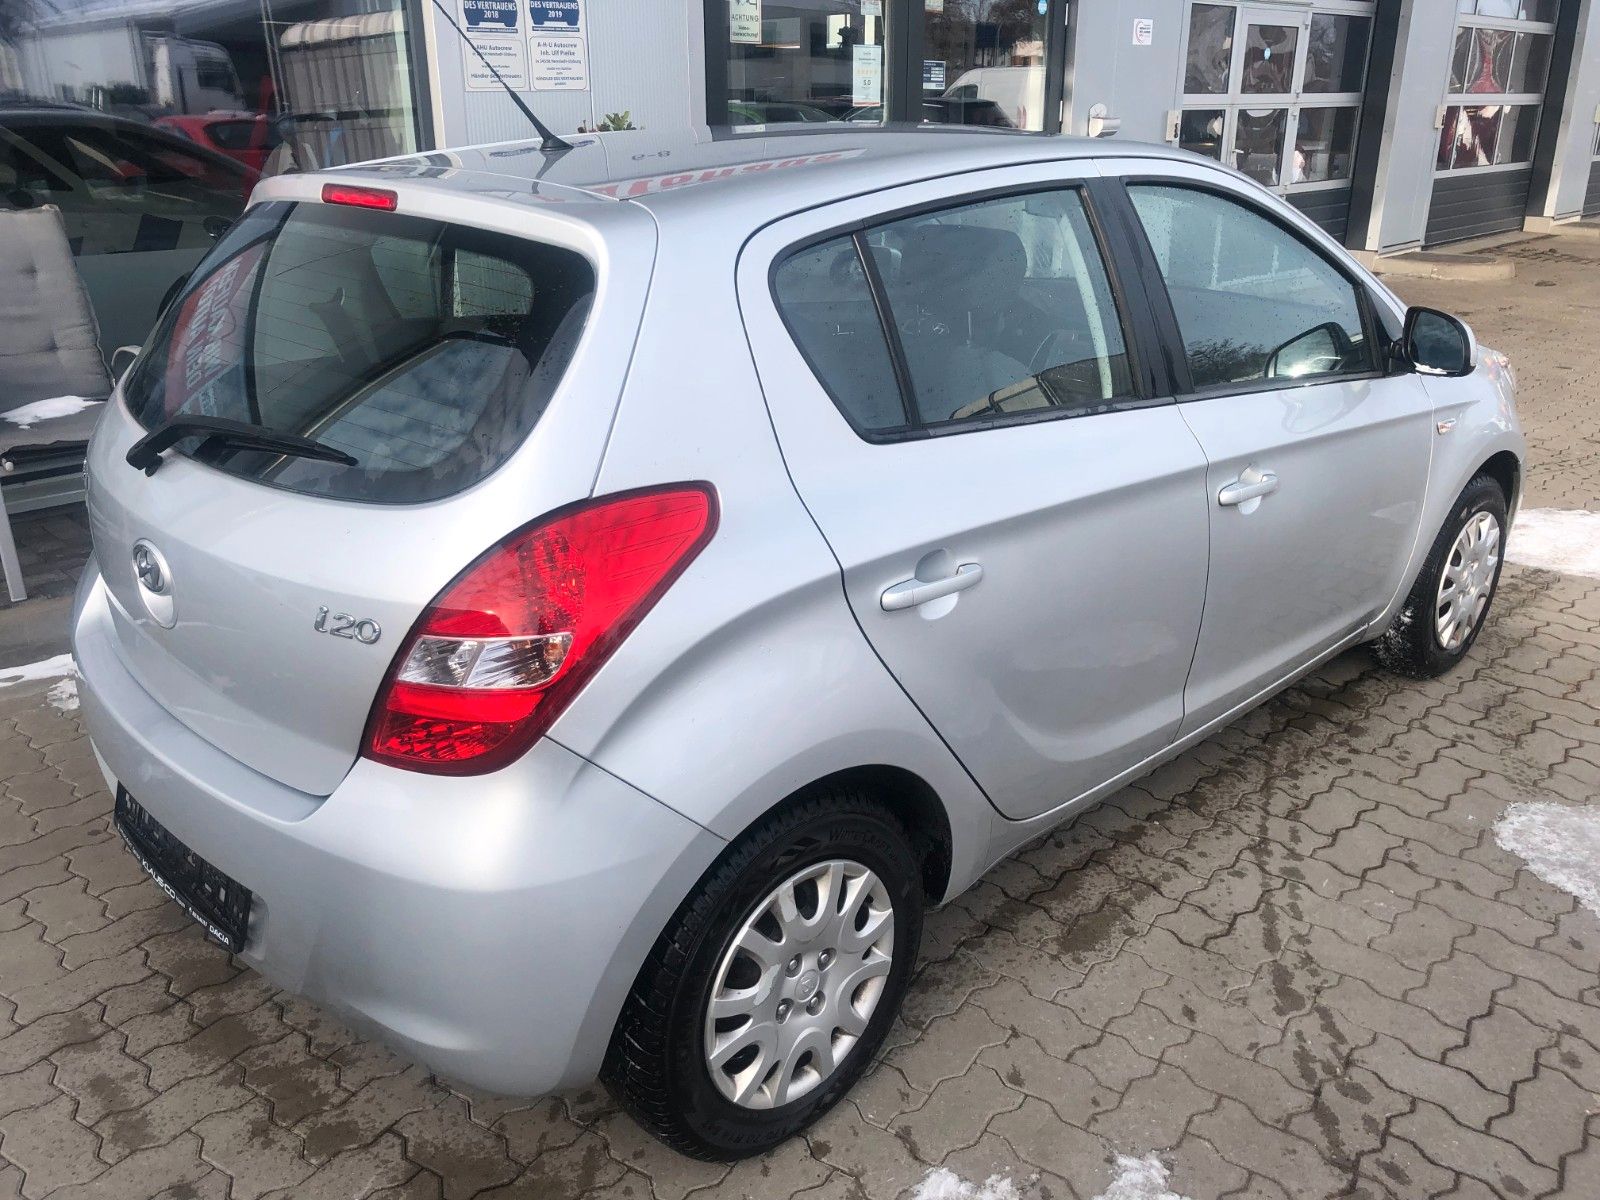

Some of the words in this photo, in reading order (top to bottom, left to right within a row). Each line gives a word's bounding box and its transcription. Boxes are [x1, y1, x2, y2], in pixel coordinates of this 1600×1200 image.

[464, 0, 476, 9] DES
[477, 1, 517, 11] VERTRAUENS
[542, 1, 579, 10] VERTRAUENS
[483, 10, 499, 19] 2018
[547, 10, 563, 18] 2019
[732, 13, 759, 22] ACHTUNG
[313, 604, 382, 645] i20
[209, 925, 230, 946] DACIA
